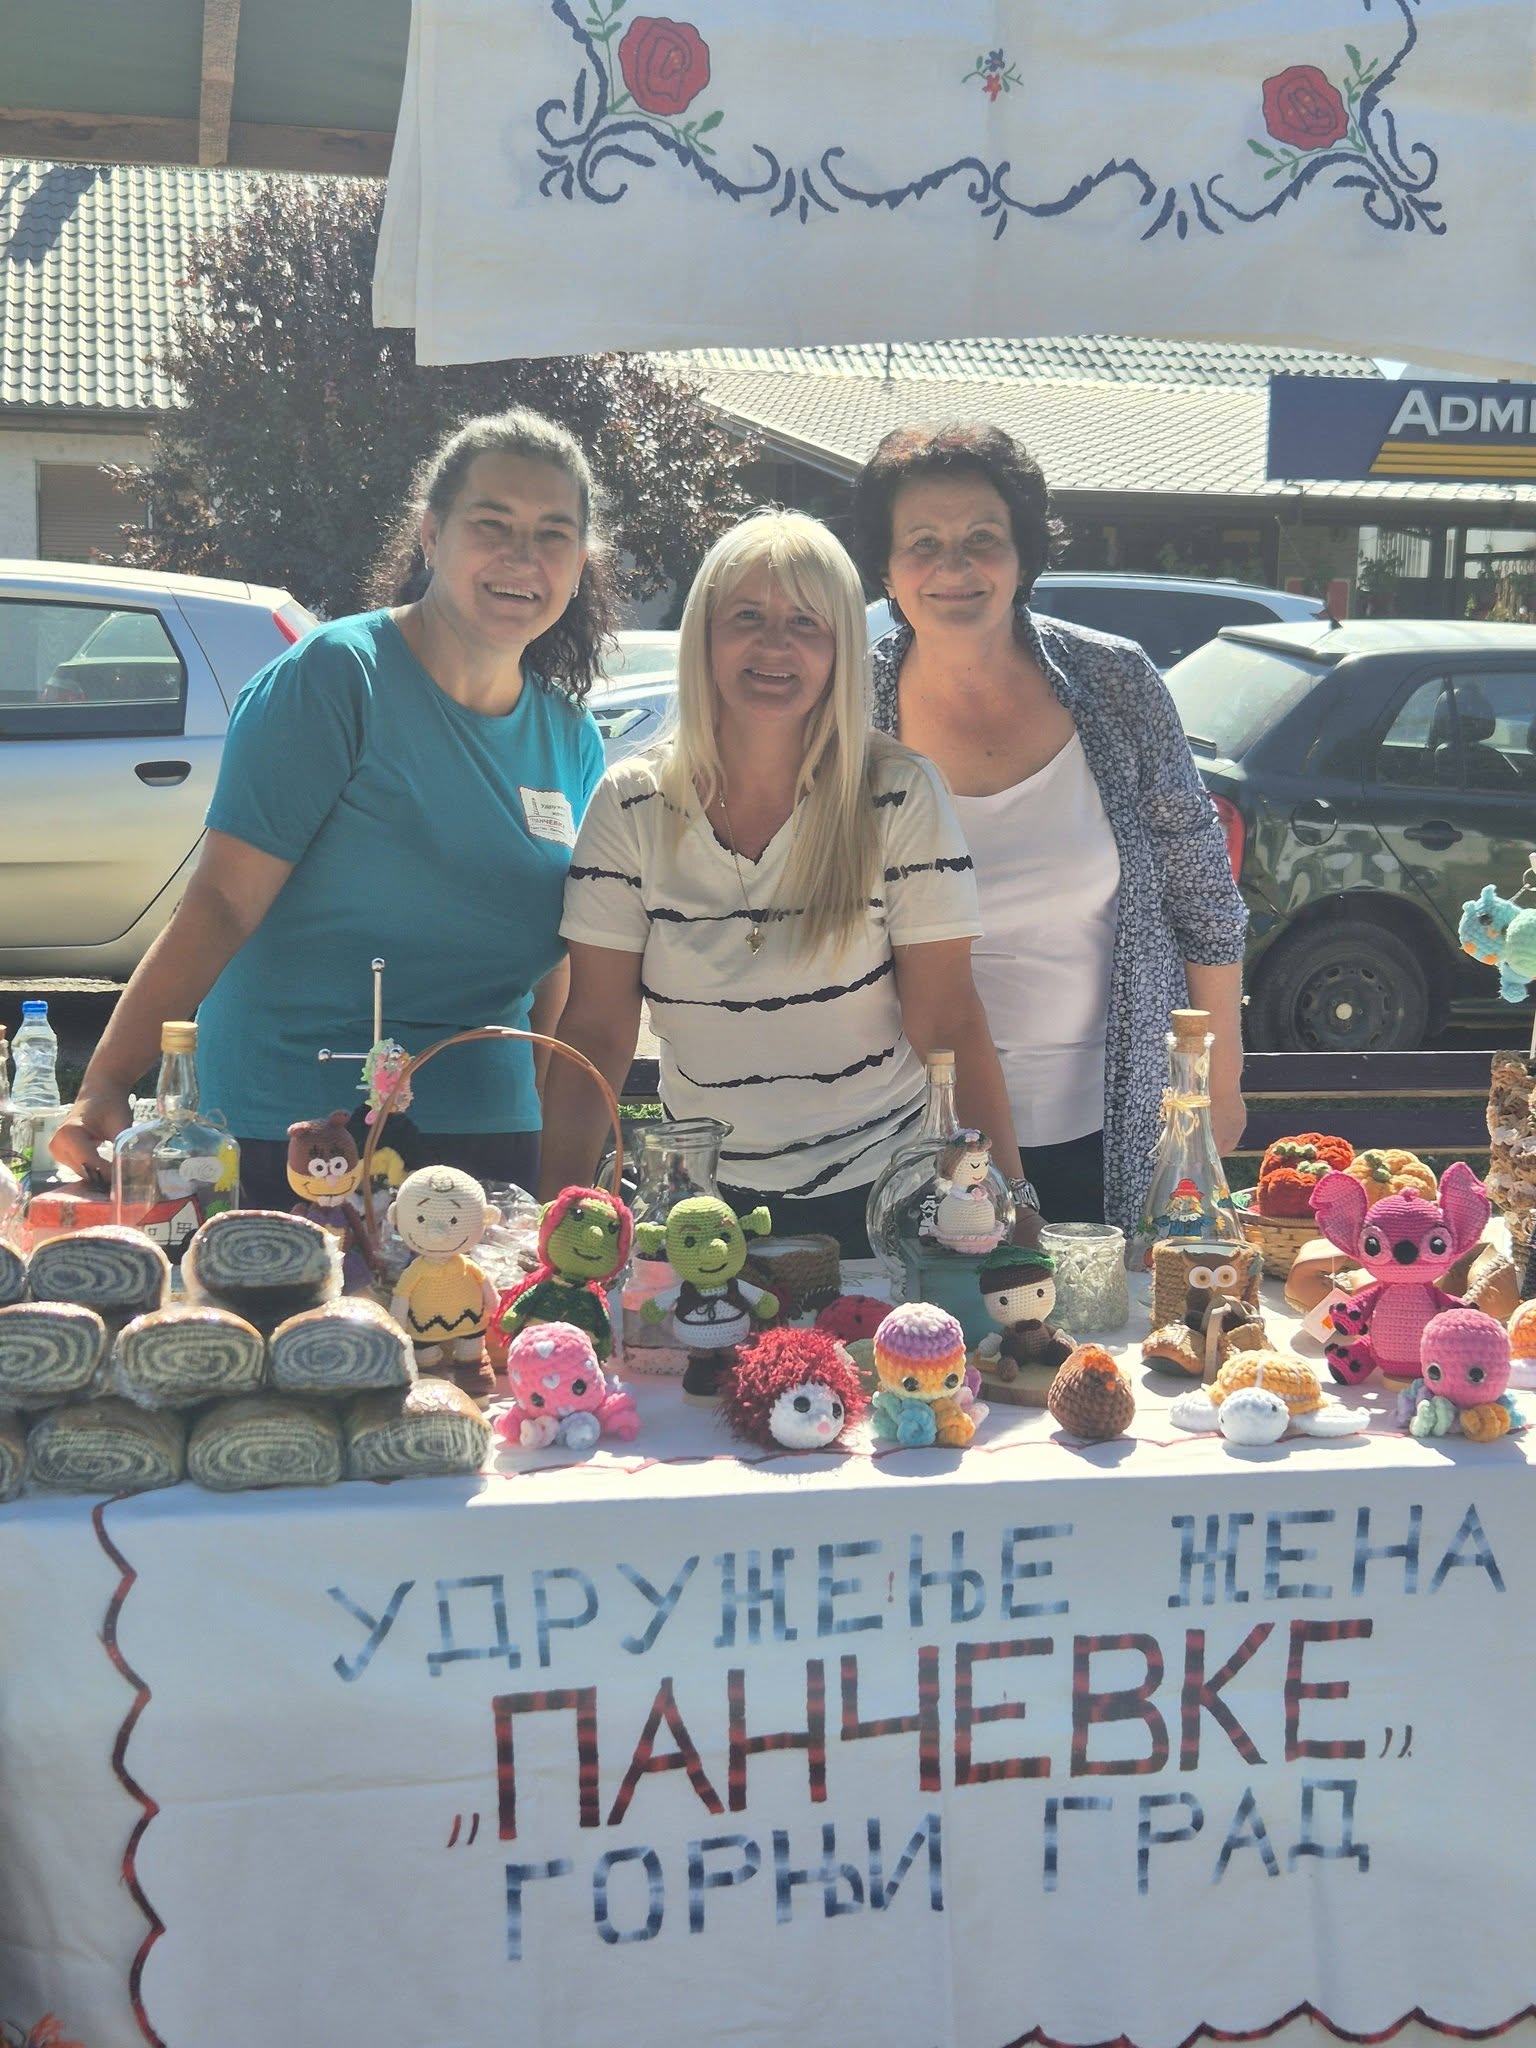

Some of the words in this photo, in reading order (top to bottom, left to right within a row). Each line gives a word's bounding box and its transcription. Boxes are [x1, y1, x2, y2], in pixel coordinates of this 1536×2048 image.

[326, 1523, 1073, 1682] УДРУЖЕЊЕ
[1168, 1503, 1507, 1608] ЖЕНА
[506, 1813, 944, 1962] ГОРЊИ
[1043, 1778, 1371, 1896] ГРАД
